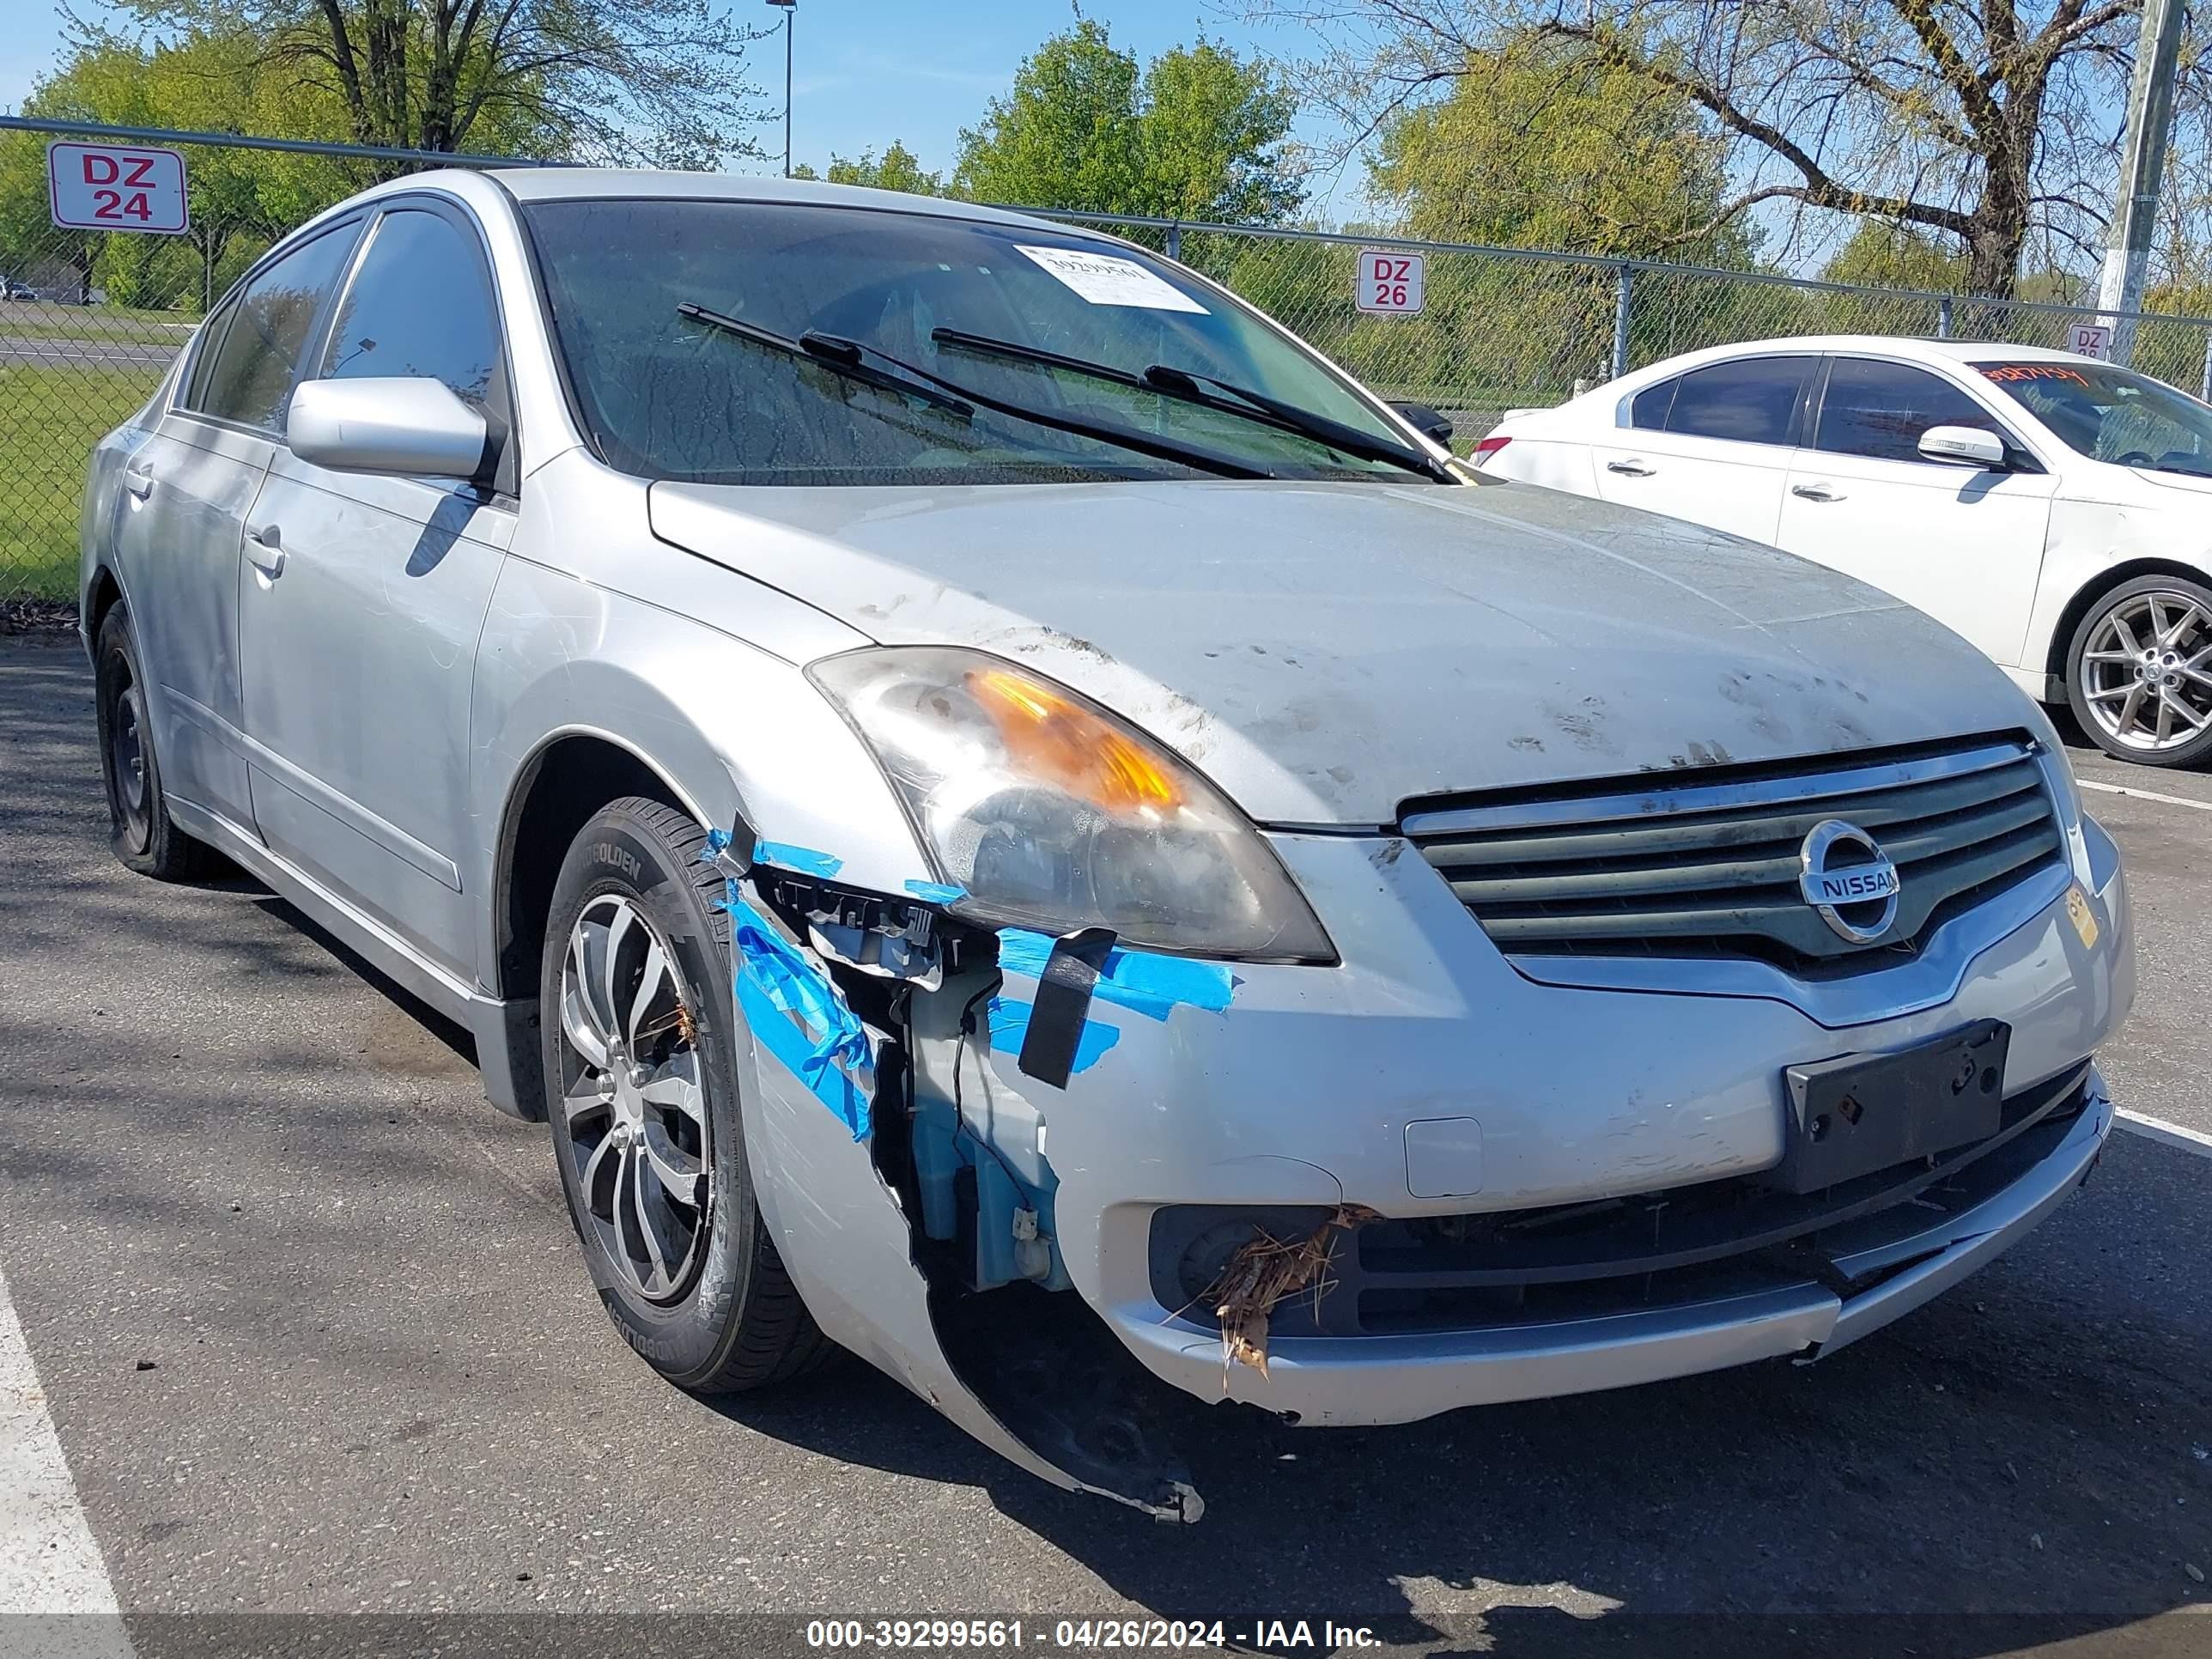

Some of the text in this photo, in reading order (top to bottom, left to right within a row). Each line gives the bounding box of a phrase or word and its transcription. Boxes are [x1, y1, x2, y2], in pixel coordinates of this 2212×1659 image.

[82, 154, 156, 189] DZ
[94, 190, 153, 221] 24
[1374, 259, 1411, 282] DZ
[1375, 284, 1407, 306] 26
[2078, 330, 2101, 348] DZ
[1822, 871, 1899, 897] NISSAN
